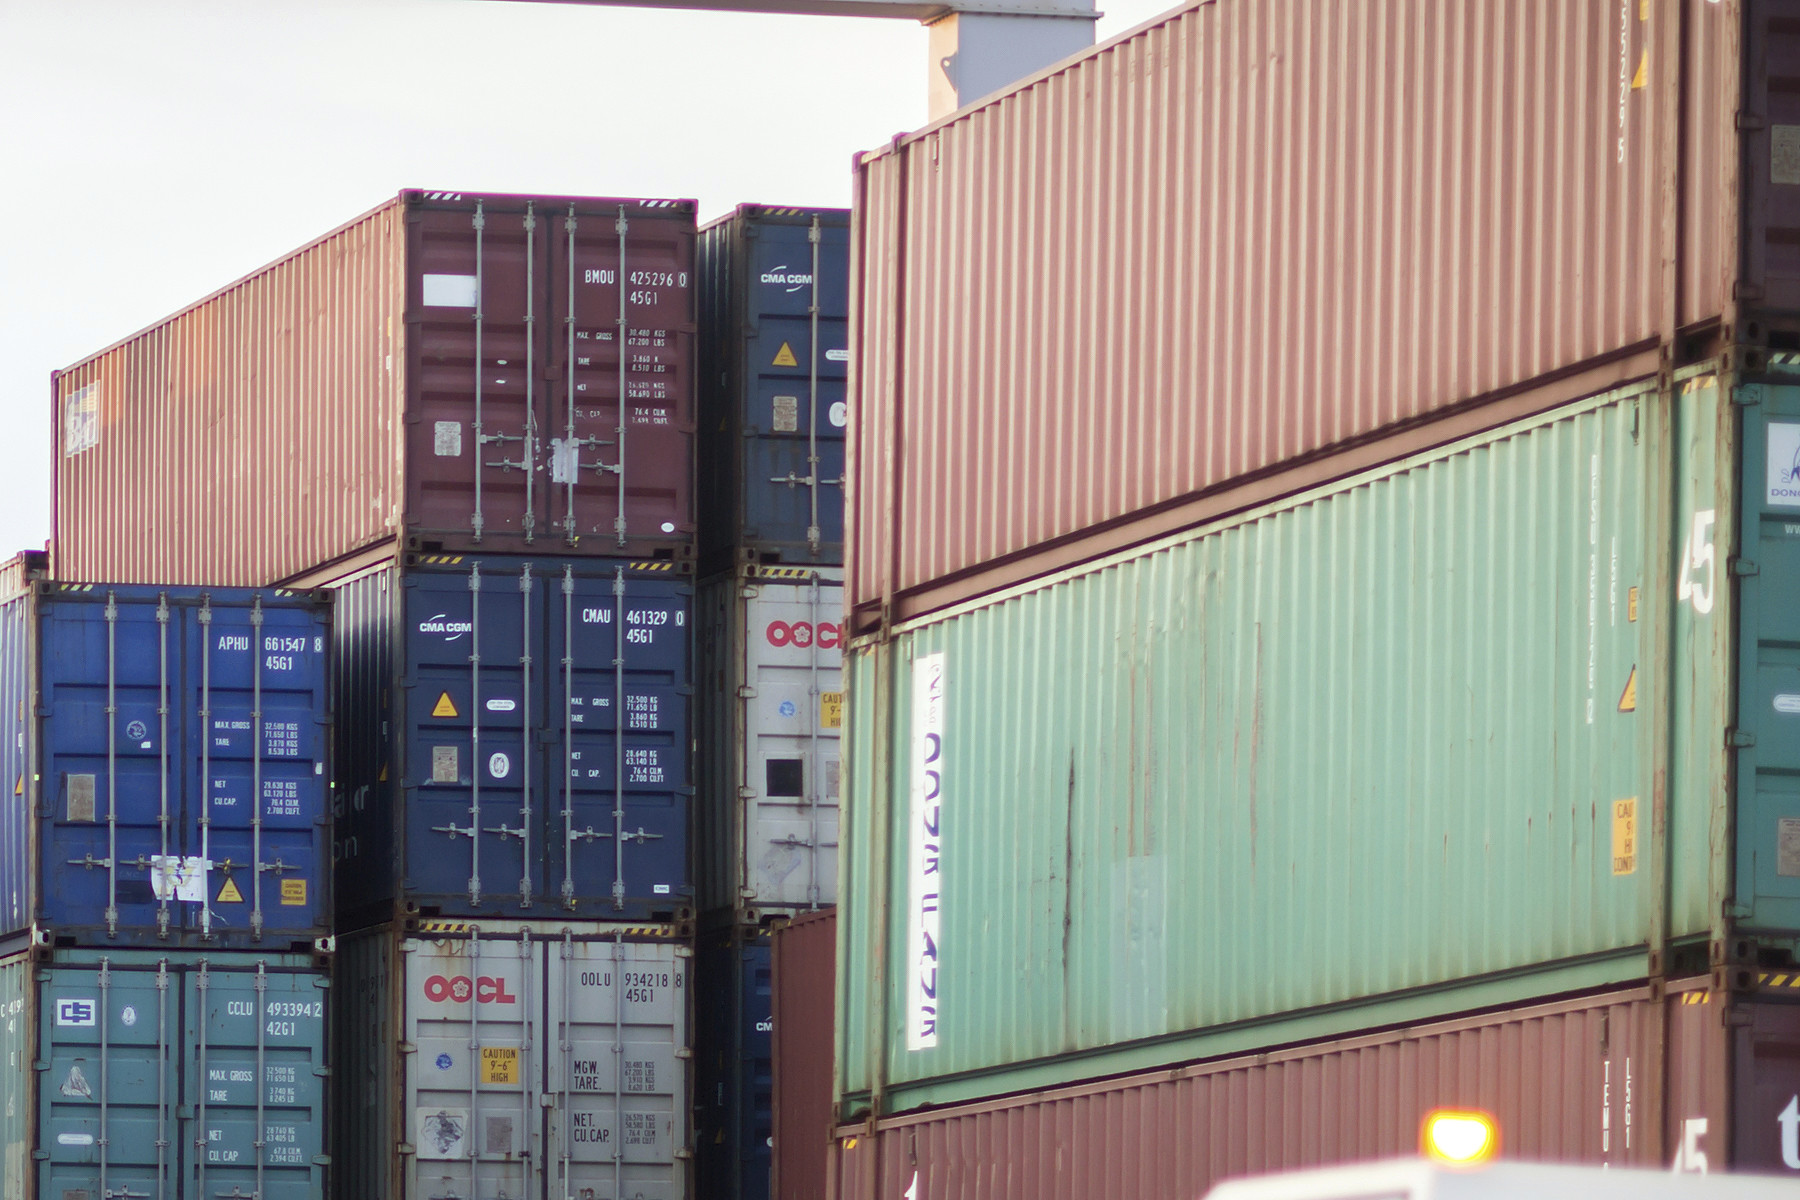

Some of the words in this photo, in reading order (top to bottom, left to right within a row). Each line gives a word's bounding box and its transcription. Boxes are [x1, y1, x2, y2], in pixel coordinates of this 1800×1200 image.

[585, 270, 614, 284] BMOU
[630, 272, 673, 287] 425296
[679, 272, 687, 287] 0
[761, 274, 786, 284] CMA
[787, 275, 812, 284] CGM
[630, 291, 657, 305] 45G1
[583, 609, 611, 624] CMAU
[626, 610, 667, 625] 461329
[675, 611, 683, 626] 0
[419, 622, 445, 632] CMA
[446, 623, 472, 632] CGM
[626, 629, 653, 643] 45G1
[218, 636, 249, 650] APHU
[265, 637, 305, 652] 661547
[314, 637, 322, 652] 8
[266, 656, 292, 670] 45G1
[626, 695, 648, 704] 32.500
[649, 696, 658, 704] KG
[822, 693, 841, 704] CAUT
[627, 703, 648, 711] 71.650
[649, 704, 658, 712] LB
[629, 720, 647, 728] 8.510
[649, 721, 658, 729] LB
[626, 757, 647, 765] 63.140
[649, 758, 657, 766] LB
[633, 767, 647, 775] 76.4
[215, 780, 226, 788] NET
[629, 774, 647, 782] 2.700
[625, 973, 668, 987] 934218
[675, 973, 682, 988] 8
[424, 974, 516, 1004] OOCL
[626, 989, 653, 1003] 45G1
[228, 1001, 253, 1016] CCLU
[267, 1002, 311, 1017] 493394
[314, 1002, 322, 1017] 2
[267, 1021, 295, 1036] 42G1
[756, 1022, 773, 1031] CM
[483, 1049, 516, 1058] CAUTION
[574, 1060, 599, 1074] MGW.
[230, 1070, 252, 1081] GROSS
[491, 1073, 508, 1082] HIGH
[574, 1076, 601, 1090] TARE.
[209, 1089, 227, 1101] TARE
[574, 1113, 595, 1127] NET.
[209, 1129, 223, 1141] NET
[223, 1150, 239, 1162] CAP
